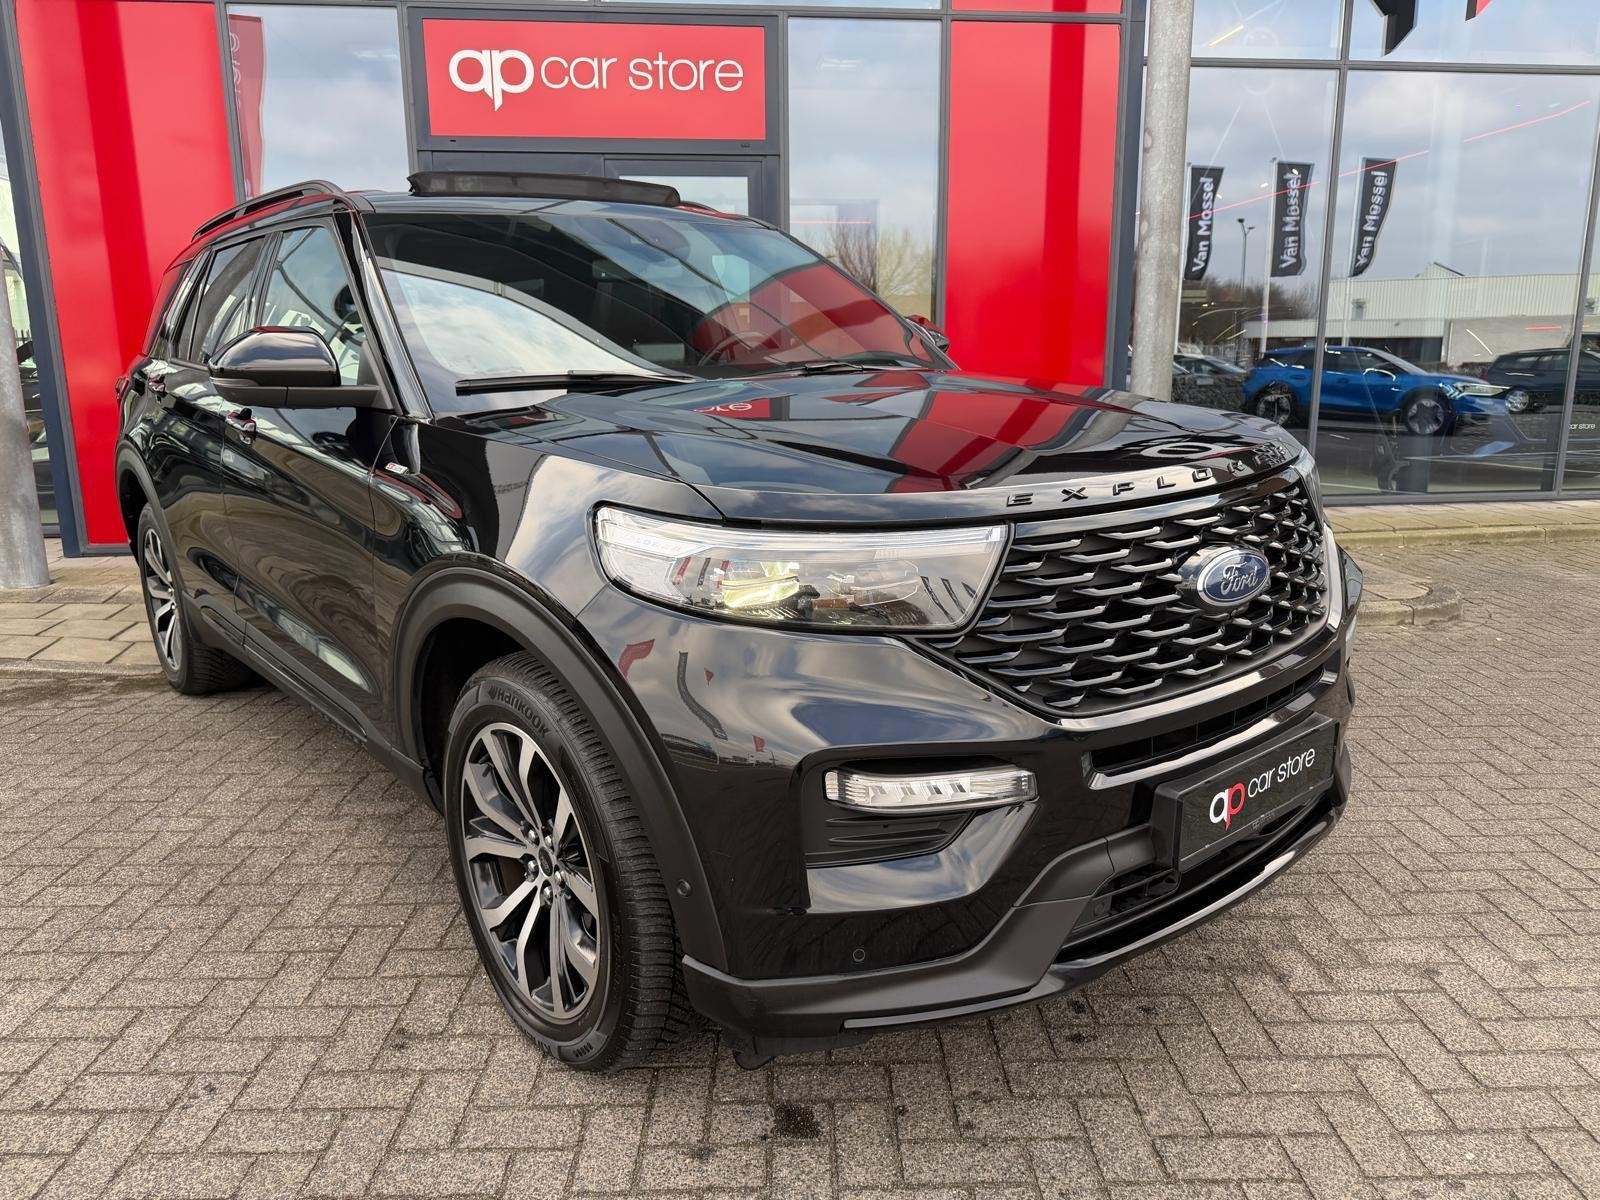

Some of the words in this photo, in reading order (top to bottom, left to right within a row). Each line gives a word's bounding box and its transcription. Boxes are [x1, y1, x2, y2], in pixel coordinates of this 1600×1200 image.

[448, 48, 535, 113] ap
[540, 56, 618, 90] car
[627, 51, 744, 92] store
[1197, 177, 1214, 236] Mossel
[1283, 171, 1302, 233] Mossel
[1363, 170, 1388, 231] Mossel
[1192, 240, 1210, 272] Van
[1279, 236, 1299, 269] Van
[1354, 235, 1375, 268] Van
[1220, 563, 1261, 596] Ford
[1209, 783, 1246, 831] ap
[1247, 767, 1276, 798] car
[1277, 748, 1316, 783] store
